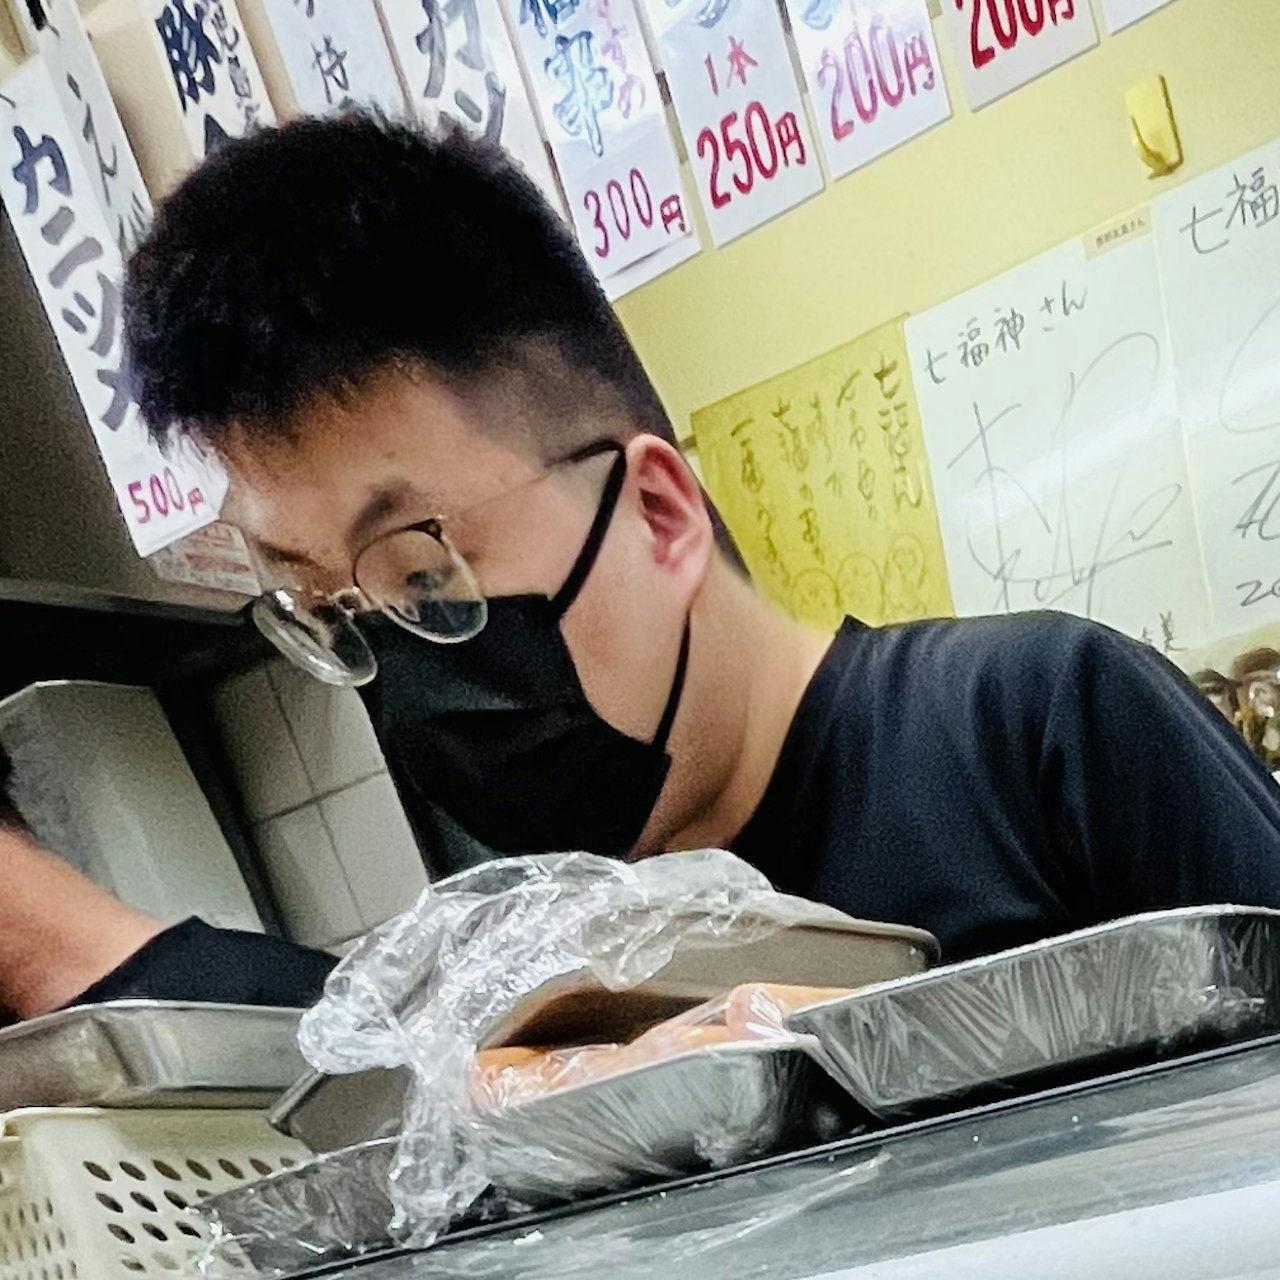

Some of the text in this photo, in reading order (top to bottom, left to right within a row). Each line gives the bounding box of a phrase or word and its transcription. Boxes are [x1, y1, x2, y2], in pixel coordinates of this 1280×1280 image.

[697, 100, 807, 210] 250円
[582, 168, 688, 259] 300円
[923, 279, 1087, 386] 七福神さん
[127, 466, 206, 526] 500円
